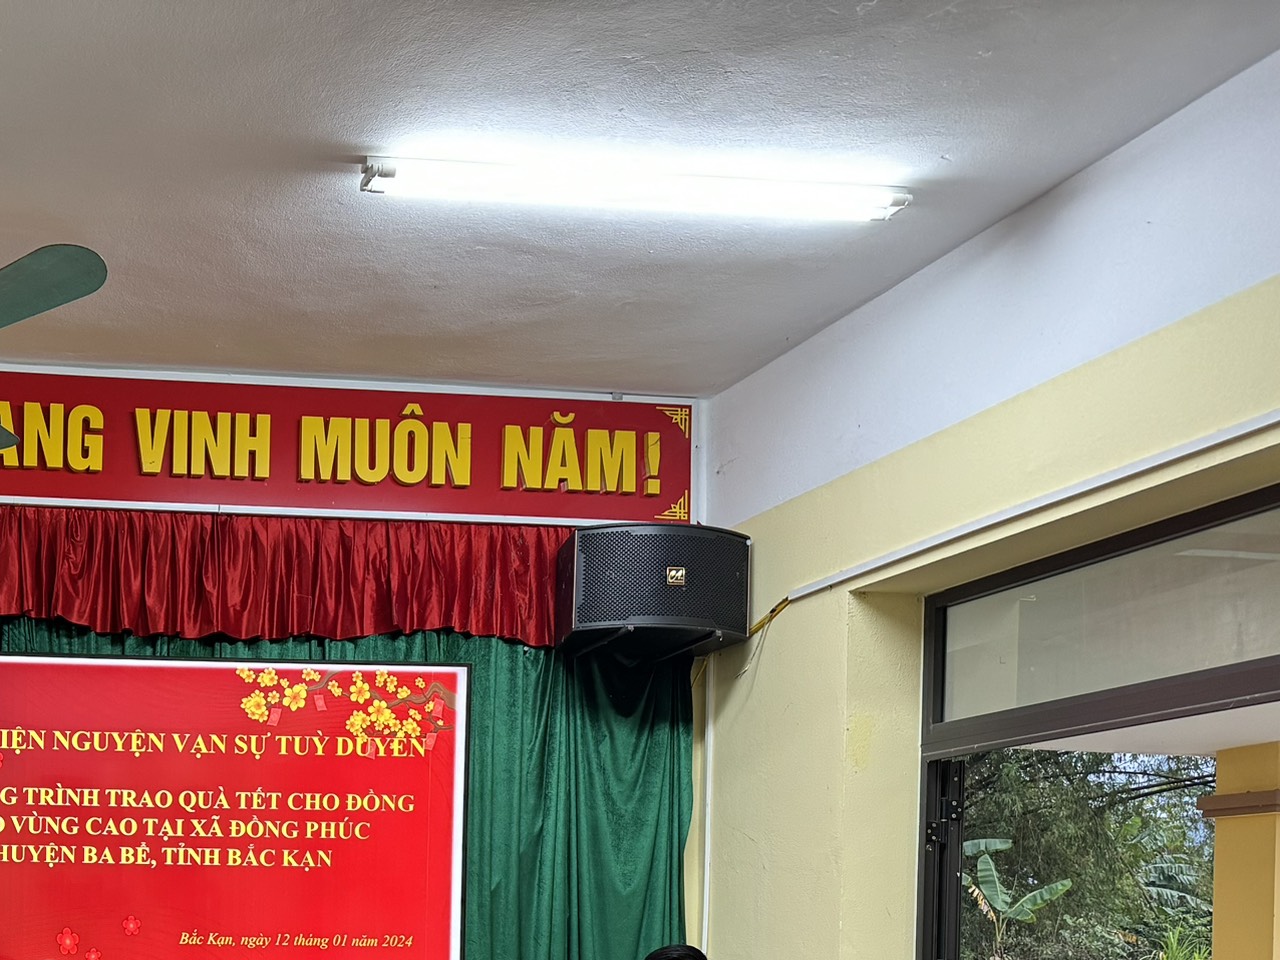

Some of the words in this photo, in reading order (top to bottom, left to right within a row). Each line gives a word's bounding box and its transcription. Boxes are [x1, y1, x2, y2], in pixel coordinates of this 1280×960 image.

[135, 407, 271, 480] VINH
[300, 403, 473, 488] MUÔN
[52, 728, 166, 758] NGUYỆN
[171, 732, 228, 760] VẠN
[234, 731, 272, 760] SỰ
[275, 730, 330, 756] TUỲ
[23, 782, 100, 807] TRÌNH
[105, 788, 173, 809] TRAO
[178, 785, 231, 812] QUÀ
[235, 786, 282, 810] TẾT
[287, 792, 341, 811] CHO
[345, 788, 416, 813] ĐỒNG
[10, 811, 80, 836] VÙNG
[85, 817, 138, 837] CAO
[142, 818, 185, 842] TẠI
[190, 815, 224, 838] XÃ
[229, 815, 300, 839] ĐỒNG
[305, 817, 372, 840] PHÚC
[81, 845, 116, 865] BA
[161, 842, 222, 866] TỈNH
[226, 843, 276, 867] BẮC
[281, 849, 334, 872] KẠN
[179, 928, 205, 945] Bắc
[207, 932, 236, 947] Kạn,
[240, 932, 271, 949] ngày
[275, 932, 290, 946] 12
[293, 933, 329, 949] tháng
[332, 933, 348, 947] 01
[351, 935, 378, 948] năm
[382, 935, 414, 948] 2024
